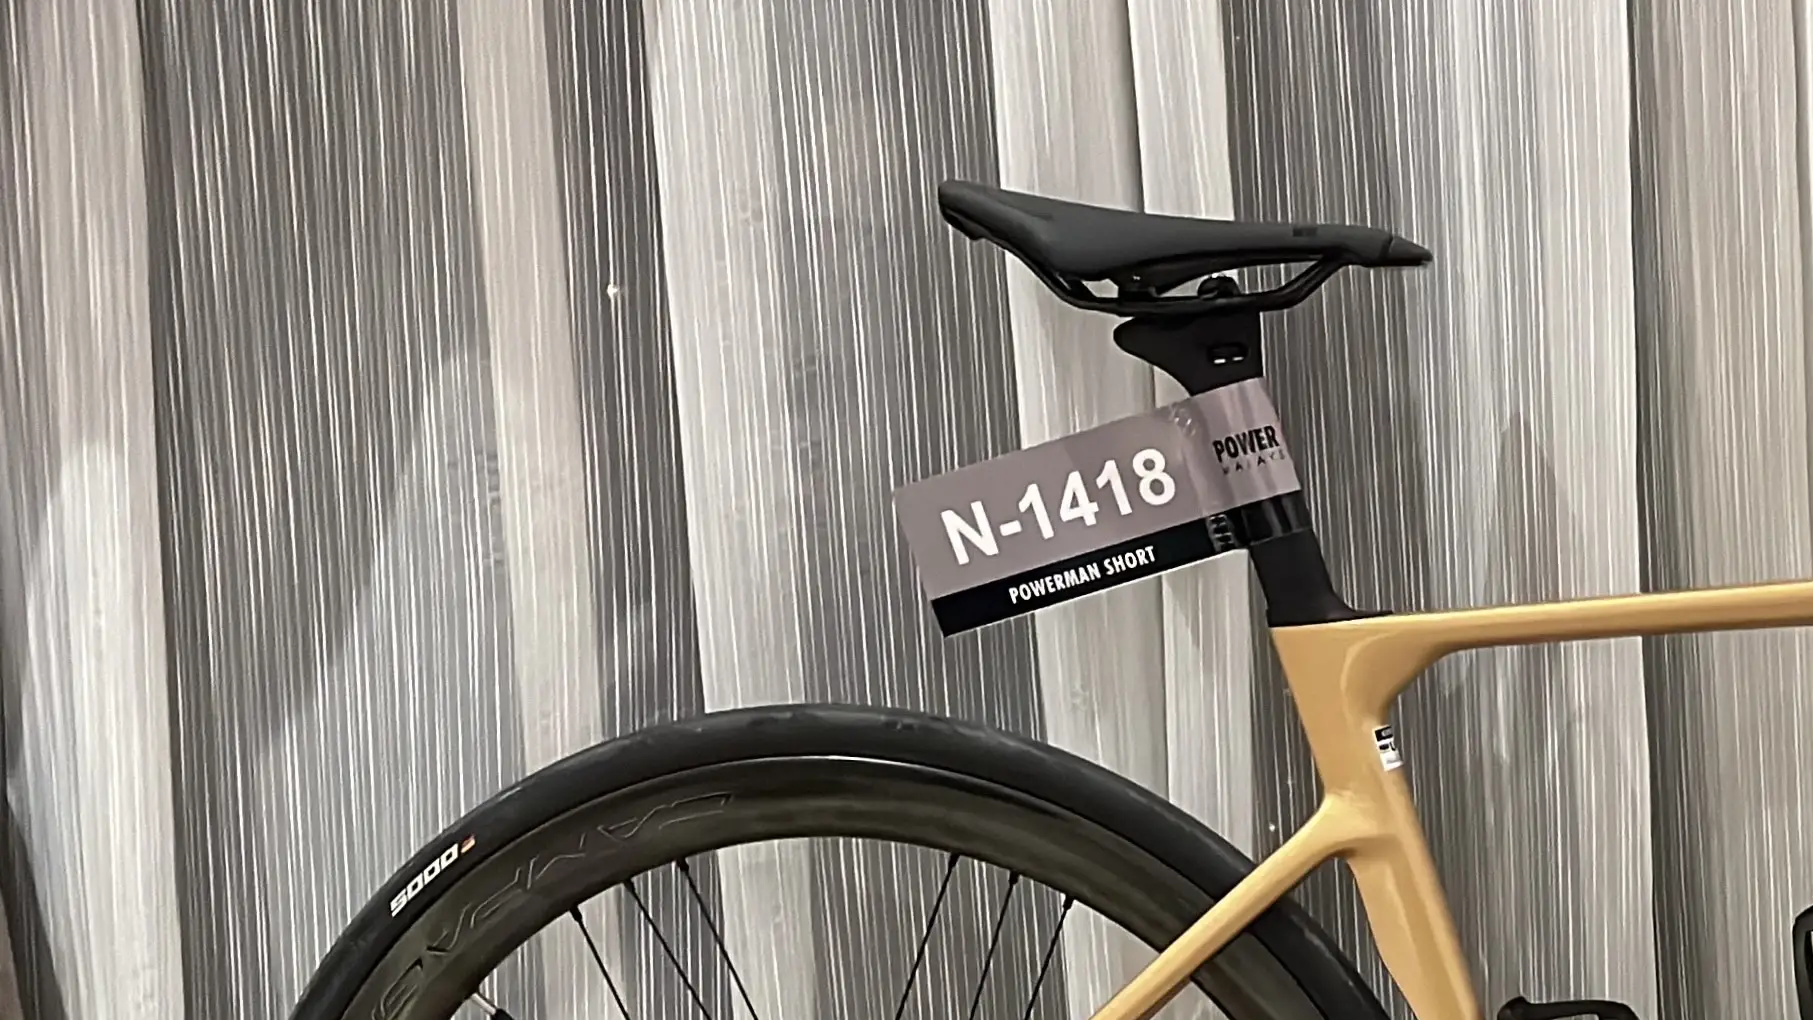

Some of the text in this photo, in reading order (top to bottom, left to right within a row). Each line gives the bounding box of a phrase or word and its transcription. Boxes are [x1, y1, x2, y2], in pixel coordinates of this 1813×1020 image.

[1212, 425, 1280, 463] POWER
[940, 449, 1176, 566] N-1418
[1008, 545, 1157, 604] POWERMAN SHORT
